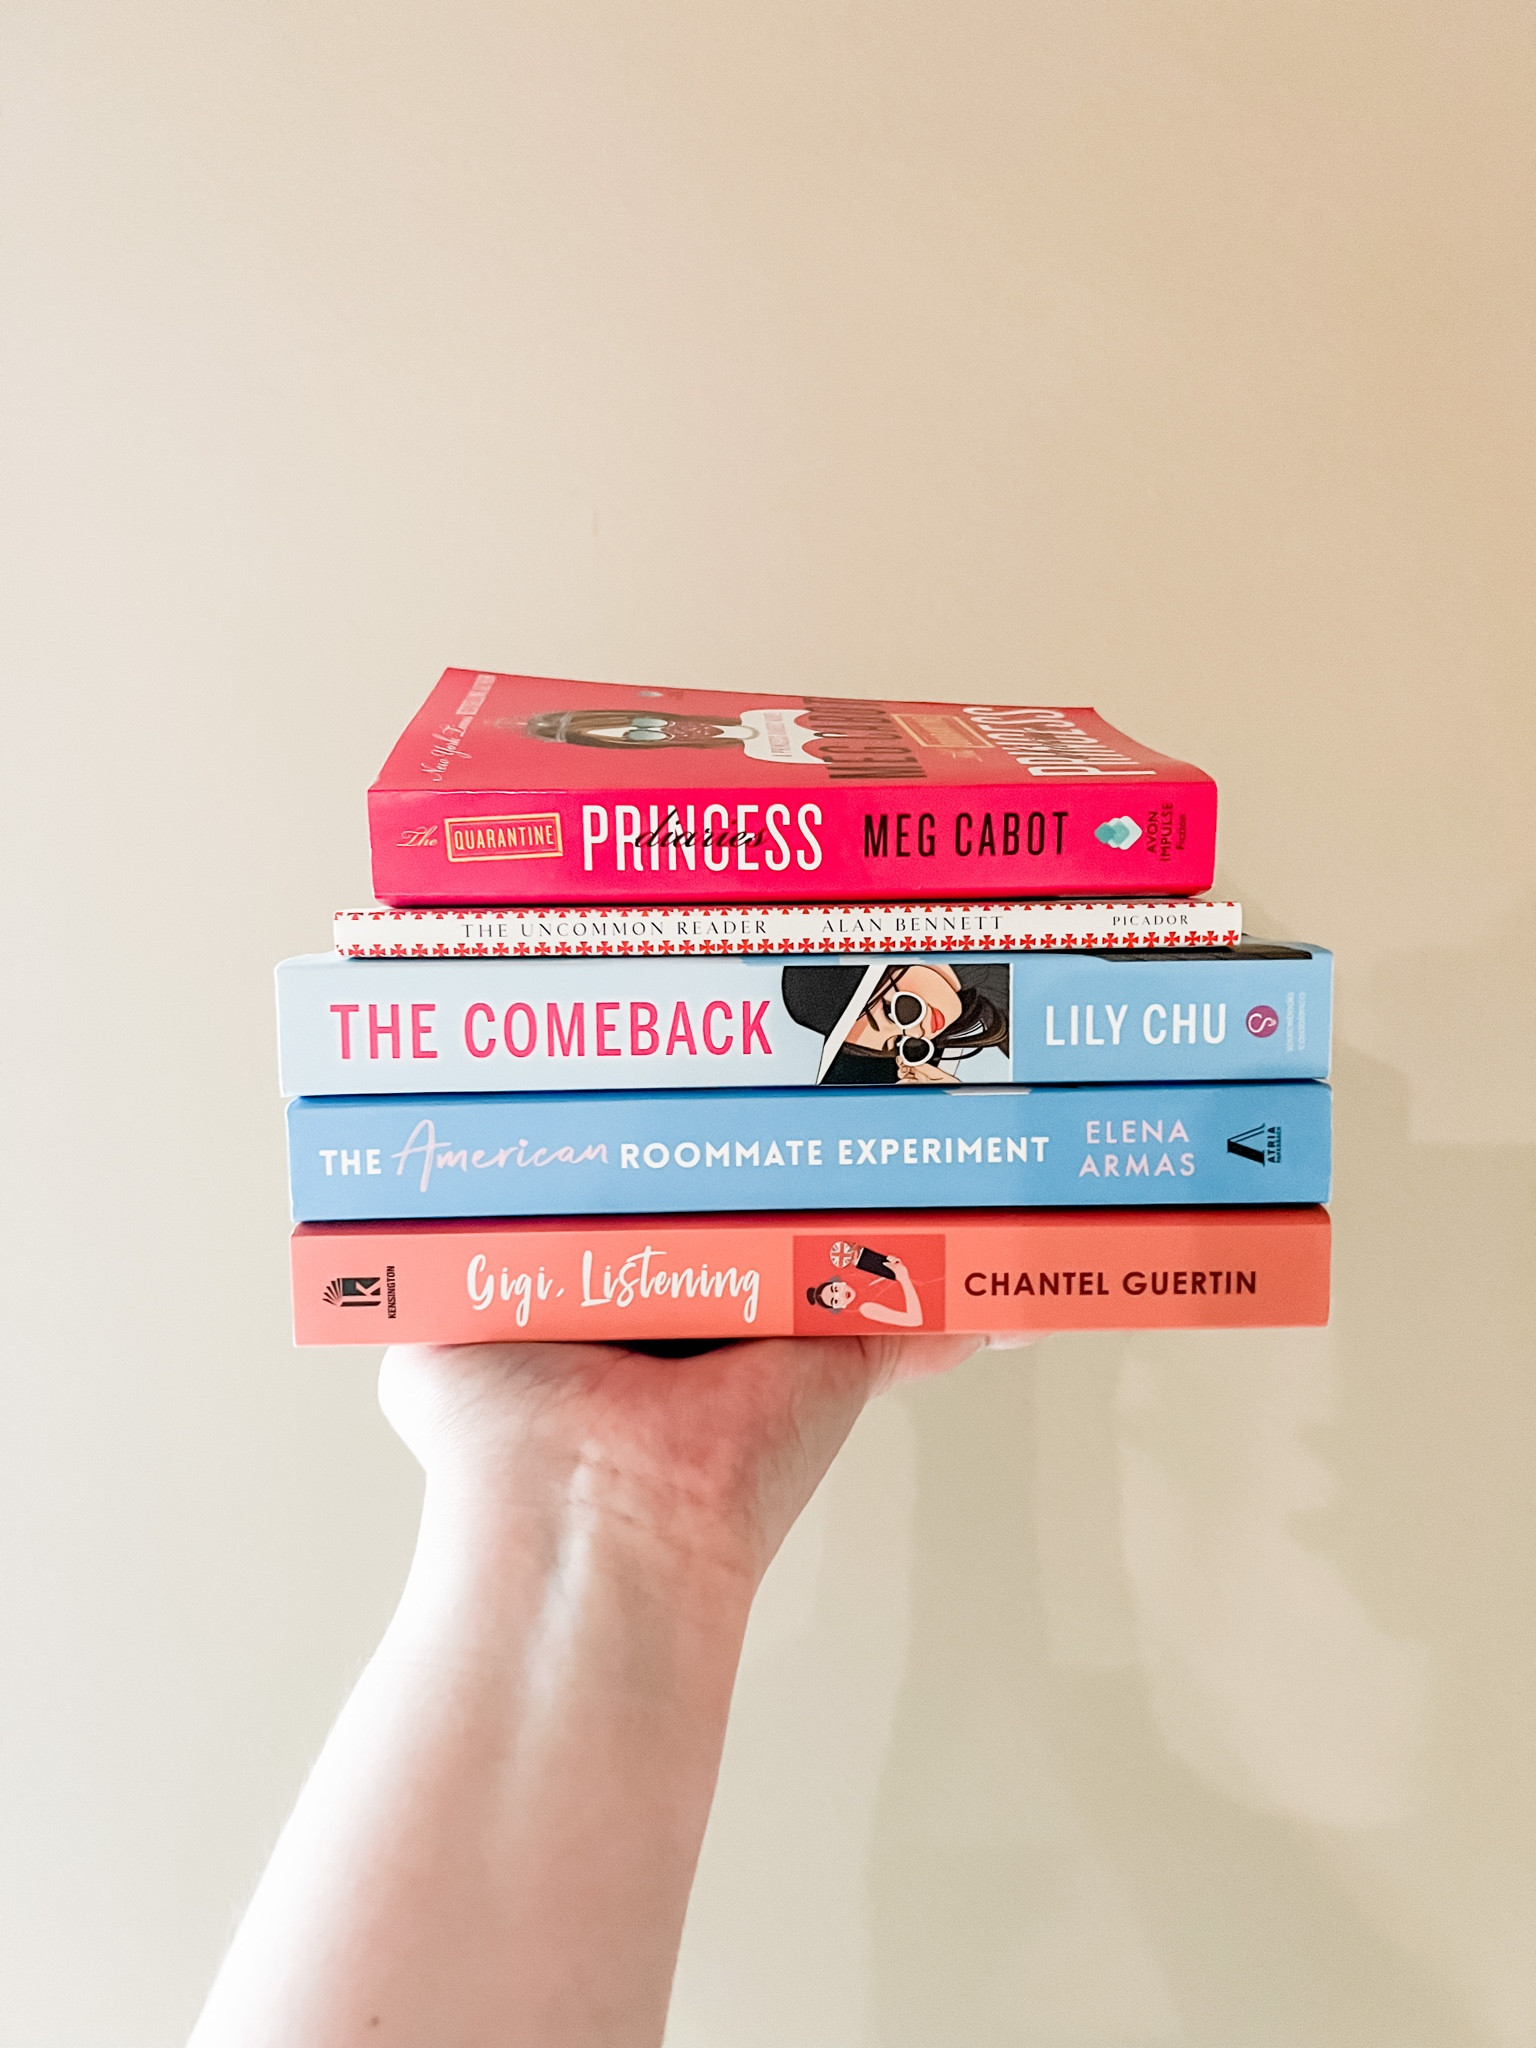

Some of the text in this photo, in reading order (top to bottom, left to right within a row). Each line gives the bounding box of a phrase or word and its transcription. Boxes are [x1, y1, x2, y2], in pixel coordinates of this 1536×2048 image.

[818, 746, 928, 779] MEG
[963, 707, 1157, 776] PRINCESS
[397, 804, 823, 871] The QUARANTINE PRINCESS
[635, 807, 769, 849] diaries
[863, 811, 1069, 857] MEG CABOT
[1147, 810, 1159, 853] AVON
[1161, 802, 1174, 861] IMPULSE
[464, 919, 767, 938] THE UNCOMMON READER
[822, 915, 1004, 933] ALAN BENNETT
[1112, 914, 1189, 927] PICADOR
[331, 1000, 773, 1060] THE COMEBACK
[1046, 1004, 1227, 1046] LILY CHU
[1086, 1120, 1189, 1144] ELENA
[1267, 1126, 1276, 1164] ATRIA
[319, 1119, 1050, 1193] THE American ROOMMATE EXPERIMENT
[1078, 1153, 1195, 1178] ARMAS
[387, 1265, 396, 1319] KENSINGTON
[466, 1245, 761, 1327] Gigi, Listening
[964, 1271, 1257, 1297] CHANTEL GUERTIN
